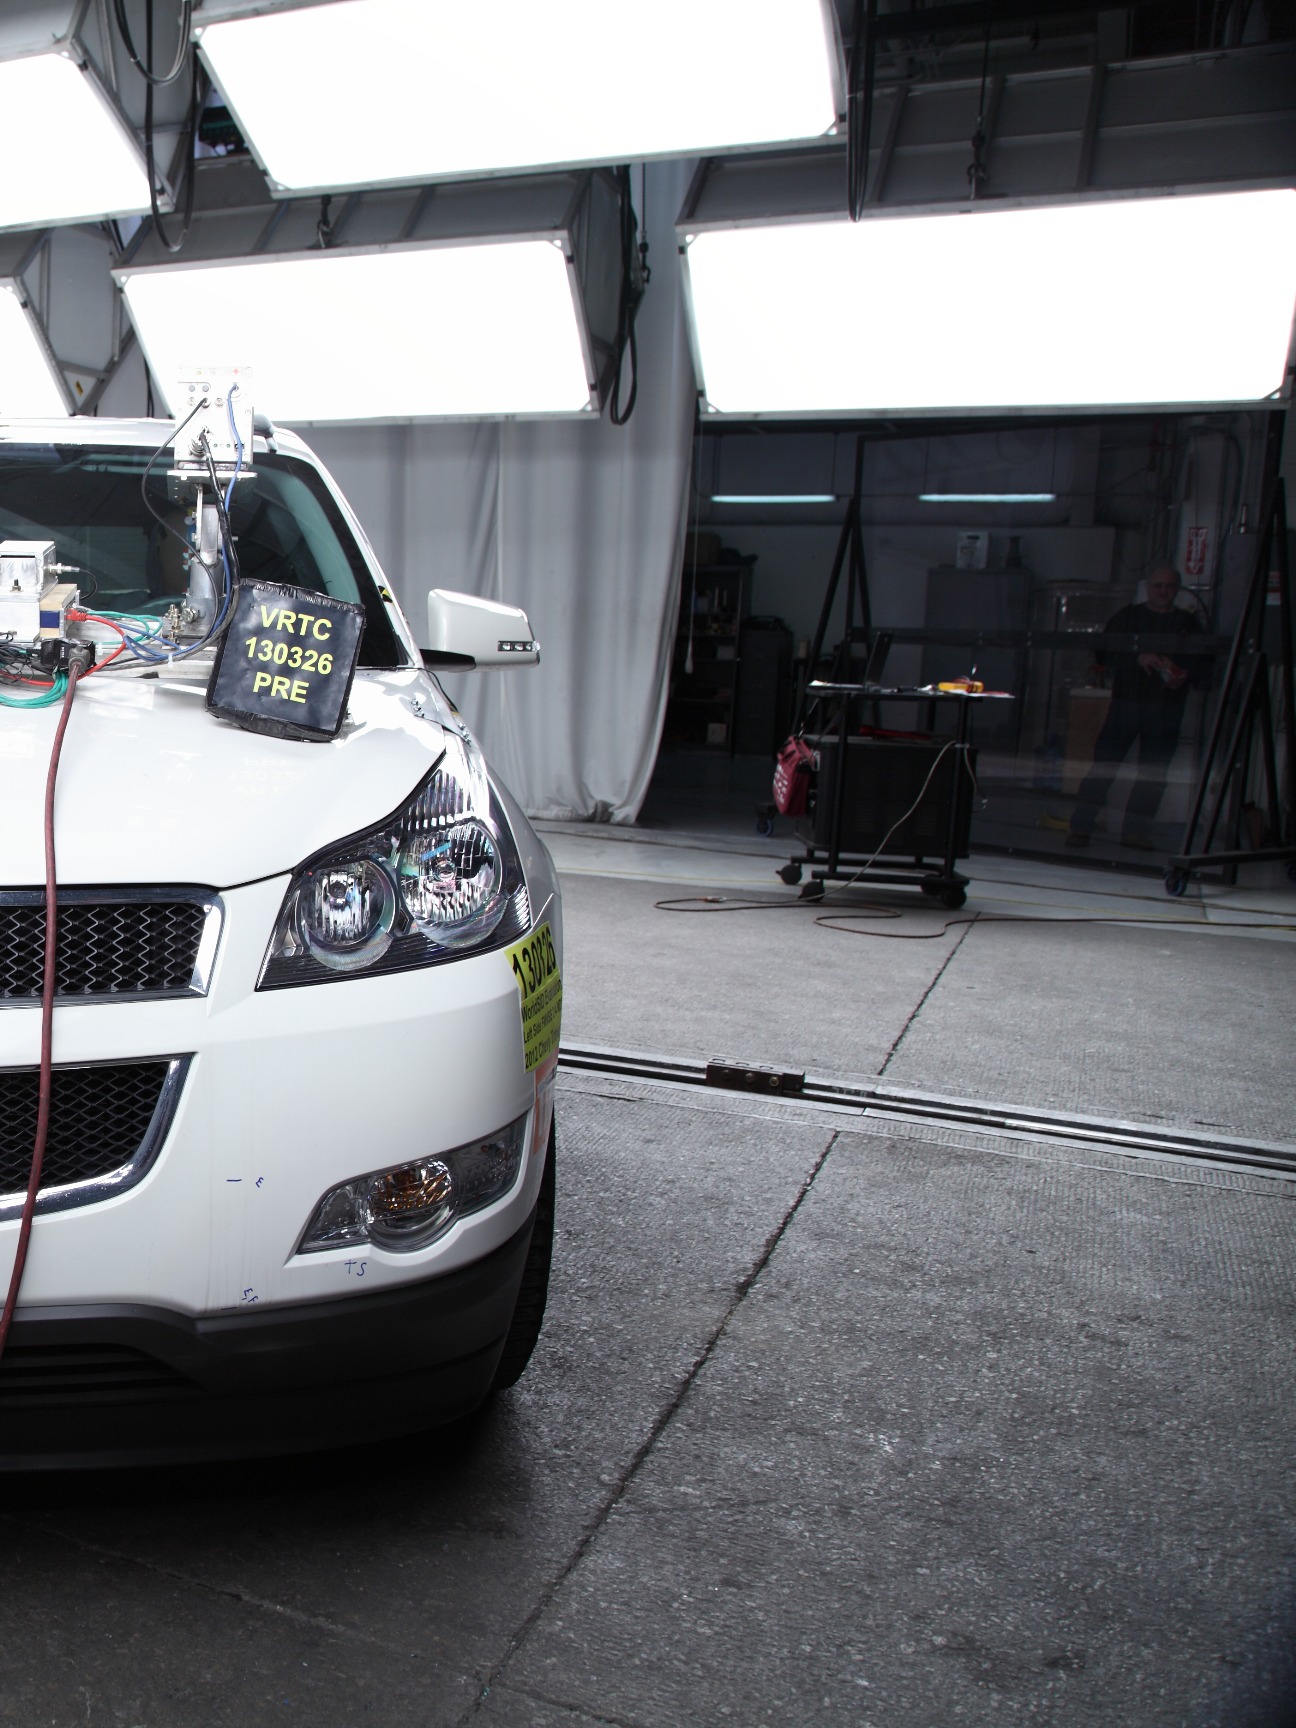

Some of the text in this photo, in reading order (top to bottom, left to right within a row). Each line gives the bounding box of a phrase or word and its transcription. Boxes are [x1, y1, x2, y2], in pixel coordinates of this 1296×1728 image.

[260, 605, 332, 641] VRTC
[245, 637, 333, 675] 130326
[253, 672, 309, 704] PRE
[512, 926, 556, 999] 130326
[525, 1046, 539, 1070] 2012
